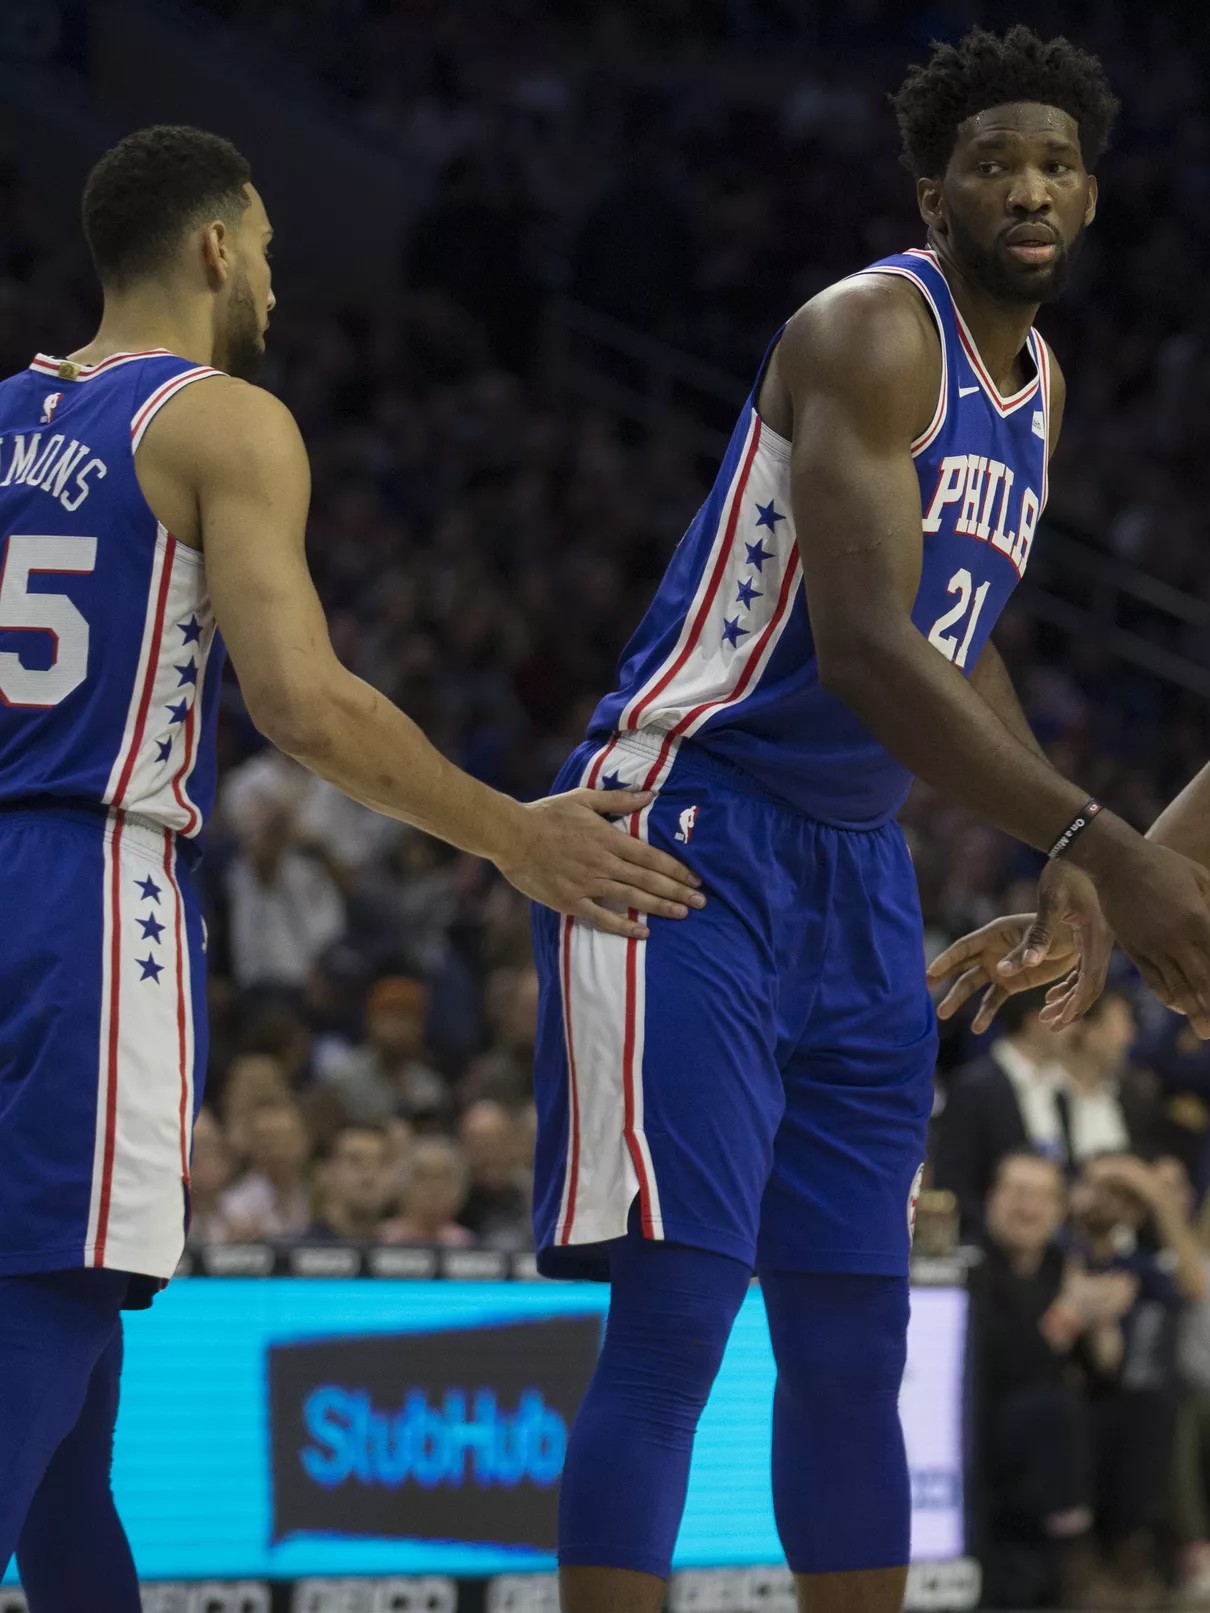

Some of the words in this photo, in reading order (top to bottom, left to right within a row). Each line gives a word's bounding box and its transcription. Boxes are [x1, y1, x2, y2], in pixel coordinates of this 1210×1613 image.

[0, 433, 107, 511] MONS
[922, 454, 1038, 579] PHILA
[0, 536, 98, 708] 5
[928, 568, 990, 668] 21
[302, 1384, 567, 1489] StubHub
